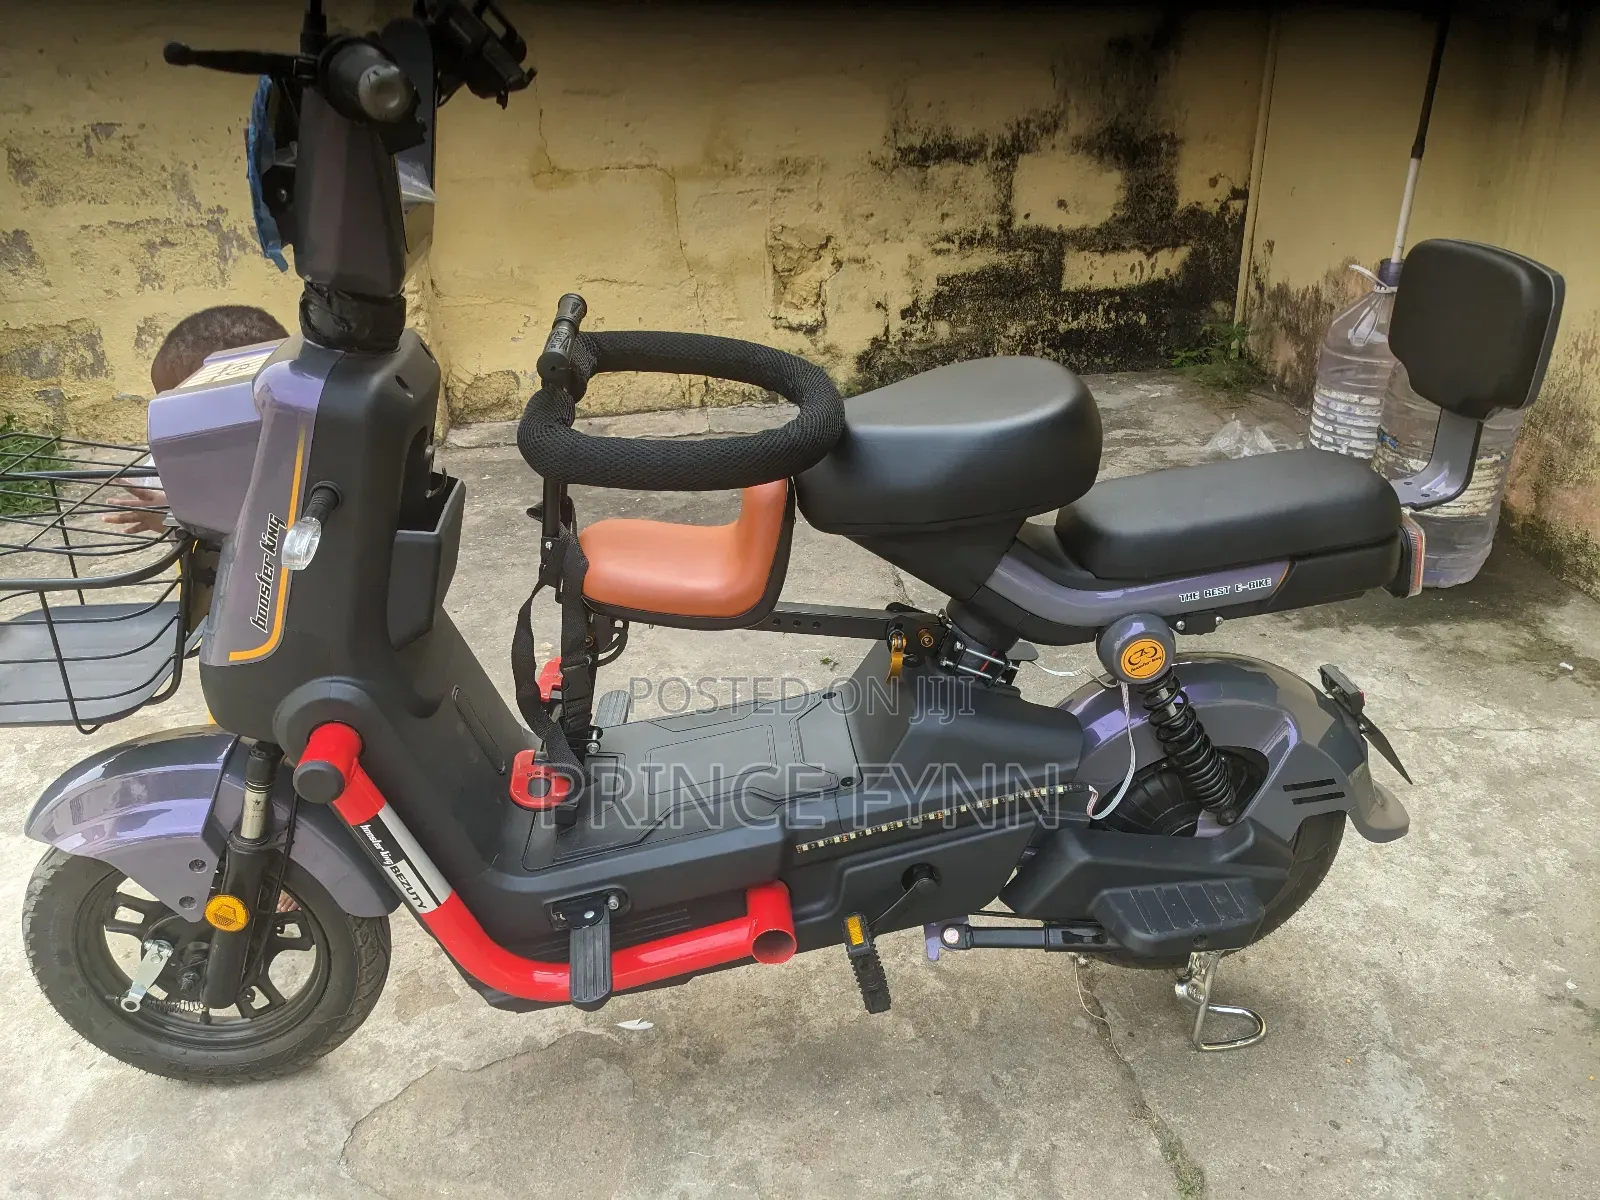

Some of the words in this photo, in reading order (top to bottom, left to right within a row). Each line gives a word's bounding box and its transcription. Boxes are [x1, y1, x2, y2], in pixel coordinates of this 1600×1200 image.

[249, 553, 275, 633] booster
[1179, 591, 1200, 602] THE
[1204, 585, 1231, 598] BEST
[1235, 578, 1271, 592] E-BIKE
[390, 865, 427, 909] BEZUTY
